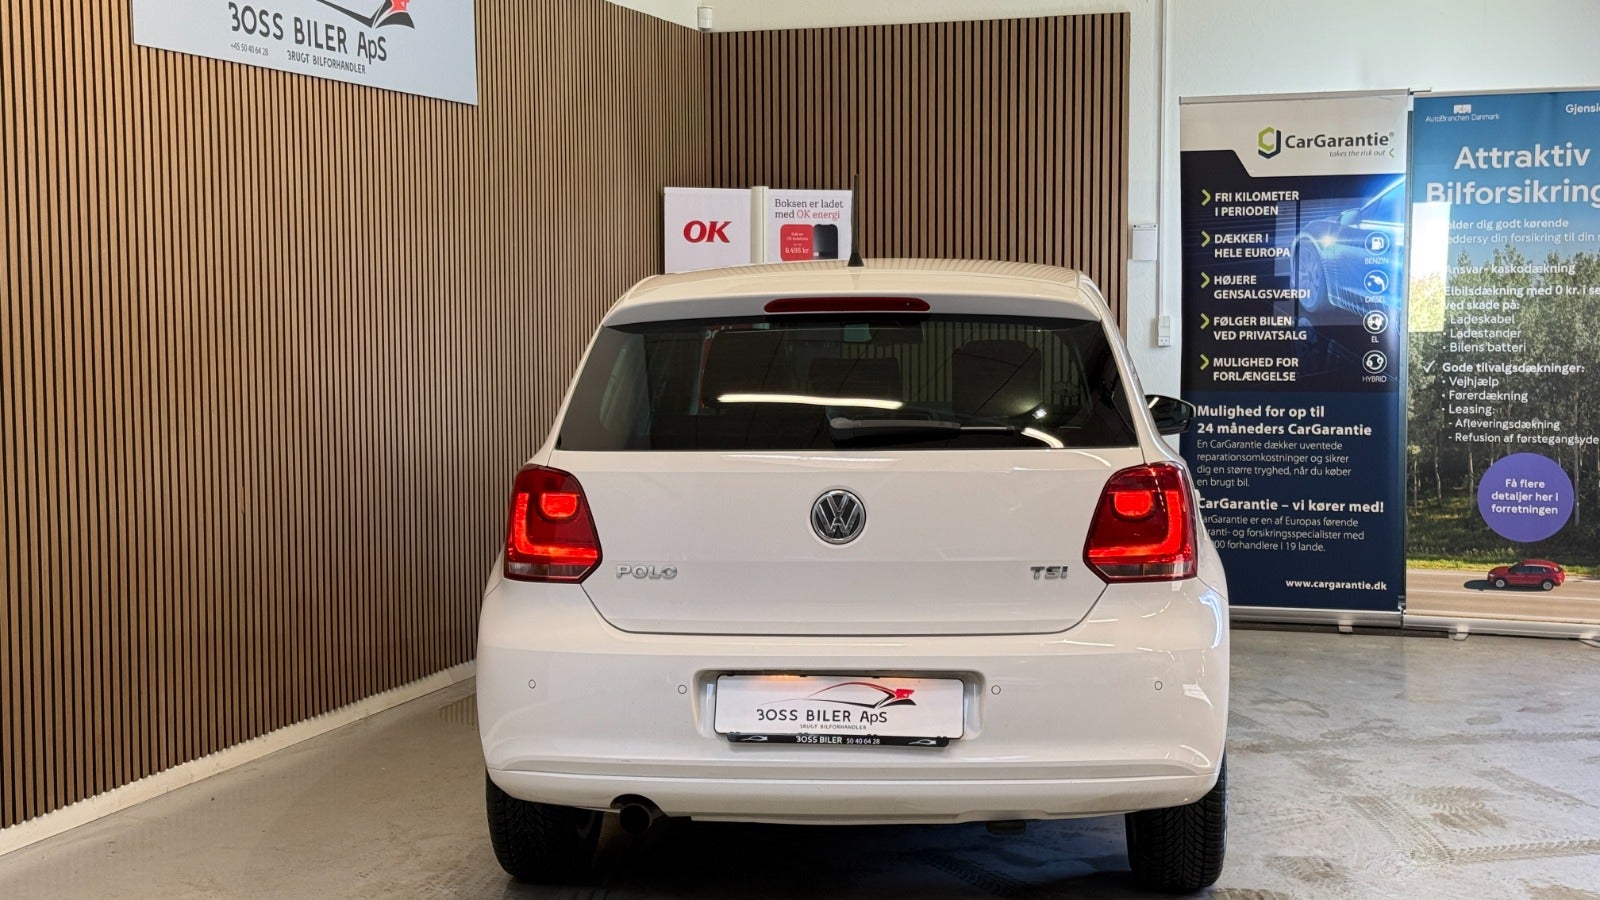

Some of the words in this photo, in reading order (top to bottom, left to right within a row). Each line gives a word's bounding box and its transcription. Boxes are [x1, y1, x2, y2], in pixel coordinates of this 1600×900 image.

[294, 16, 348, 54] BILER
[358, 32, 387, 64] ApS
[312, 56, 366, 74] BILFORHANDLER
[1565, 103, 1600, 115] Gjensi
[1348, 150, 1358, 158] the
[1454, 142, 1591, 170] Attraktiv
[1215, 192, 1232, 202] FRI
[1235, 190, 1300, 202] KILOMETER
[775, 199, 806, 208] Boksen
[821, 200, 843, 208] ladet
[775, 210, 794, 218] med
[796, 210, 810, 218] OK
[812, 211, 840, 220] energi
[1215, 208, 1218, 216] I
[1220, 206, 1278, 216] PERIODEN
[1476, 220, 1492, 230] dig
[1496, 220, 1520, 230] godt
[1524, 219, 1568, 228] kørende
[684, 220, 732, 243] OK
[1214, 234, 1262, 244] DÆKKER
[1265, 234, 1268, 243] I
[1491, 234, 1507, 242] din
[1510, 233, 1560, 244] forsikring
[1564, 232, 1574, 242] til
[1578, 232, 1594, 241] din
[1214, 248, 1242, 258] HELE
[1245, 248, 1291, 258] EUROPA
[1492, 264, 1576, 275] kaskodækning
[1214, 275, 1257, 286] HØJERE
[1214, 290, 1310, 299] GENSALGSVÆRDI
[1445, 286, 1524, 298] Elbilsdækning
[1527, 286, 1552, 296] med
[1556, 286, 1562, 294] 0
[1566, 286, 1580, 295] kr.
[1583, 285, 1586, 294] i
[1444, 300, 1464, 310] ved
[1467, 300, 1500, 310] skade
[1502, 300, 1520, 313] på:
[1214, 316, 1257, 326] FØLGER
[1260, 316, 1292, 326] BILEN
[1450, 314, 1515, 324] Ladeskabel
[1214, 331, 1237, 340] VED
[1240, 331, 1308, 340] PRIVATSALG
[1450, 328, 1522, 338] Ladestander
[1450, 342, 1484, 352] Bilens
[1488, 342, 1526, 352] batteri
[1213, 358, 1274, 368] MULIGHED
[1276, 358, 1298, 368] FOR
[1442, 362, 1474, 372] Gode
[1476, 362, 1585, 376] tilvalgsdækninger:
[1213, 372, 1296, 382] FORLÆNGELSE
[1449, 376, 1500, 388] Vejhjælp
[1450, 390, 1528, 402] Førerdækning
[1198, 406, 1262, 418] Mulighed
[1266, 406, 1285, 417] for
[1289, 408, 1306, 420] op
[1310, 406, 1324, 418] til
[1448, 404, 1496, 416] Leasing:
[1197, 424, 1214, 433] 24
[1218, 422, 1284, 434] måneders
[1288, 424, 1372, 436] CarGarantie
[1456, 433, 1500, 442] Refusion
[1504, 434, 1513, 442] af
[1198, 440, 1208, 448] En
[1210, 440, 1262, 449] CarGarantie
[1264, 441, 1298, 450] dækker
[1300, 442, 1342, 450] uventede
[1197, 454, 1308, 463] reparationsomkostninger
[1310, 456, 1322, 464] og
[1326, 454, 1349, 463] sikrer
[1197, 466, 1211, 476] dig
[1254, 466, 1291, 476] tryghed,
[1294, 466, 1308, 475] når
[1311, 467, 1322, 475] du
[1325, 468, 1351, 476] køber
[1210, 478, 1234, 488] brugt
[1237, 478, 1250, 486] bil.
[1506, 478, 1518, 488] Få
[1520, 479, 1545, 488] flere
[1492, 492, 1532, 502] detaljer
[1536, 492, 1553, 502] her
[1556, 493, 1558, 502] i
[1200, 498, 1278, 510] CarGarantie
[1292, 500, 1304, 510] vi
[1309, 501, 1346, 512] kører
[1349, 502, 1384, 512] med!
[1491, 504, 1558, 516] forretningen
[1201, 515, 1248, 524] arGarantie
[1274, 516, 1284, 524] af
[1285, 517, 1321, 526] Europas
[1323, 518, 1358, 527] førende
[1208, 528, 1230, 536] ranti-
[1232, 530, 1244, 538] og
[1246, 528, 1341, 540] forsikringsspecialister
[1344, 531, 1364, 540] med
[1214, 540, 1226, 548] 00
[1228, 540, 1278, 550] forhandlere
[1286, 542, 1296, 550] 19
[1299, 542, 1326, 552] lande.
[616, 564, 678, 580] POLO
[1030, 565, 1068, 580] TSI
[1286, 580, 1387, 591] www.cargarantie.dk
[806, 710, 851, 722] BILER
[860, 710, 888, 725] ApS
[820, 736, 842, 744] BILER
